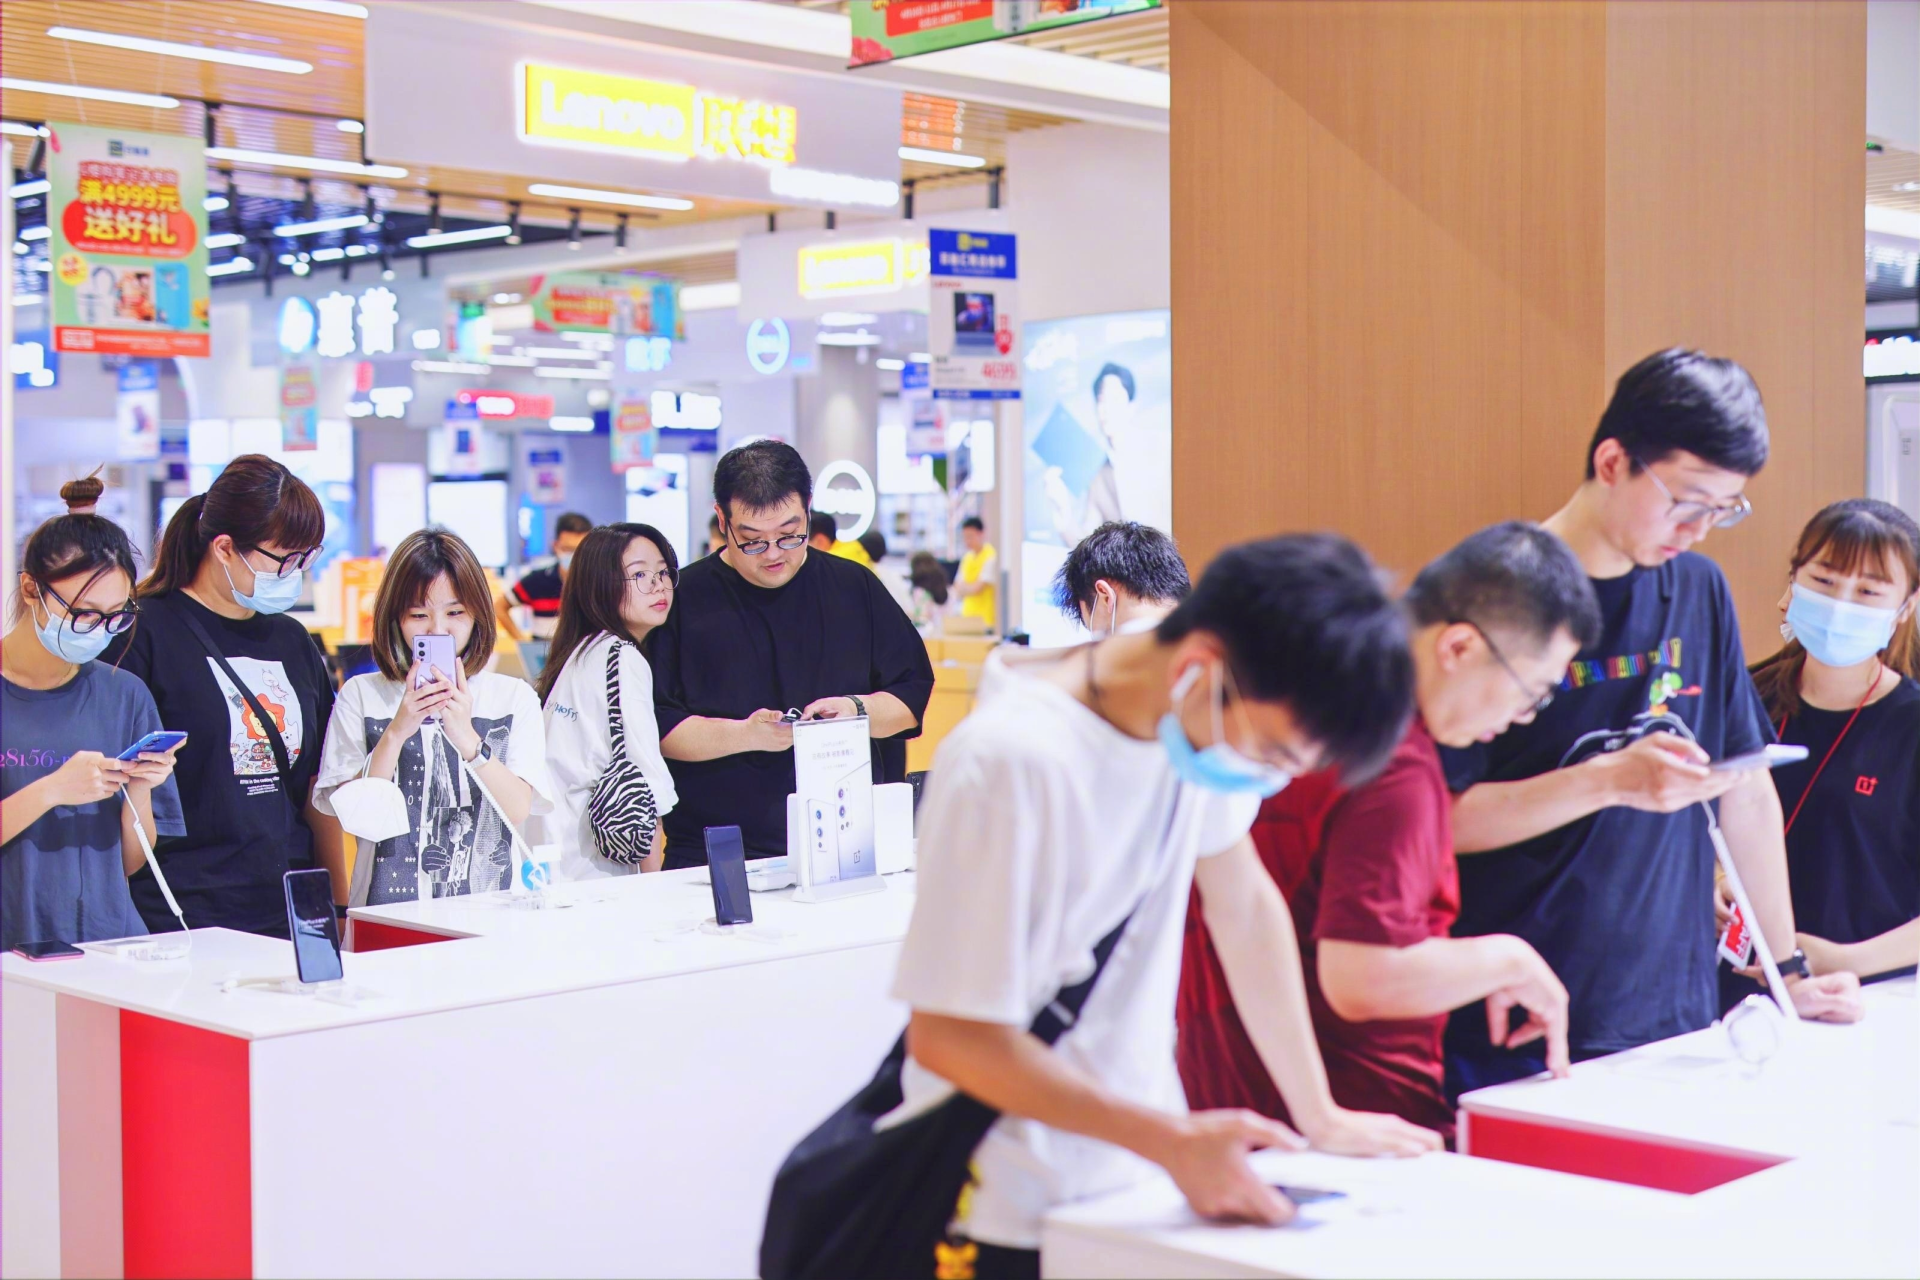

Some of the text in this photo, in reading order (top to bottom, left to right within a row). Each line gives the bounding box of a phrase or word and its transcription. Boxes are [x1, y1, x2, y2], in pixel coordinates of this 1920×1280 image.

[541, 80, 685, 140] Lenovo
[79, 178, 180, 214] 满4999元
[84, 205, 178, 245] 送好礼
